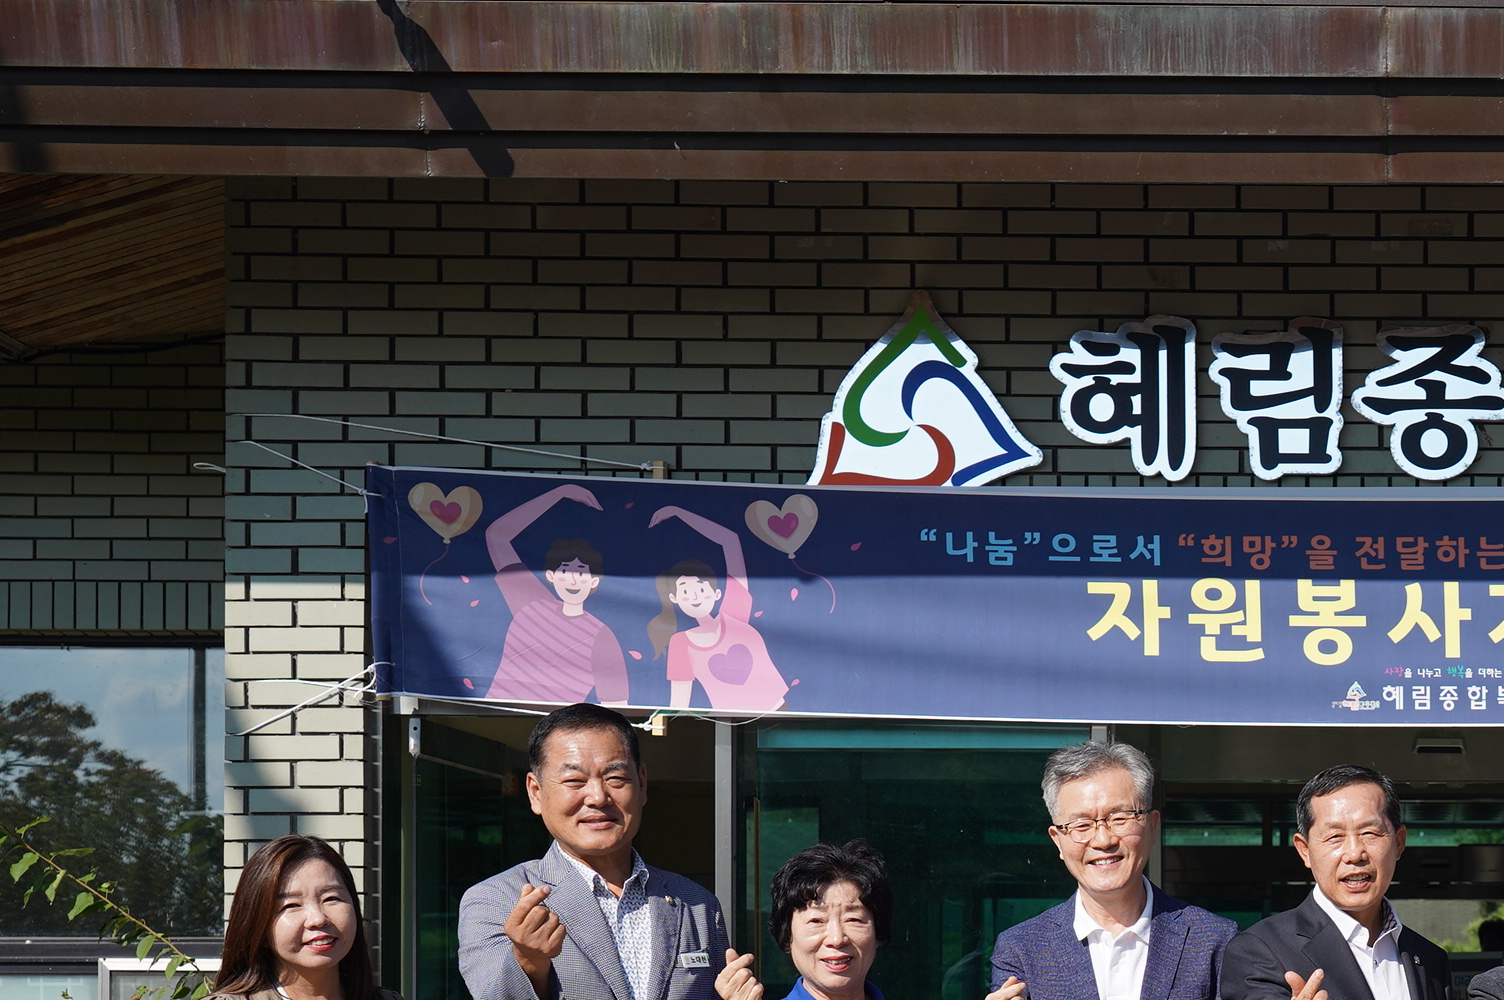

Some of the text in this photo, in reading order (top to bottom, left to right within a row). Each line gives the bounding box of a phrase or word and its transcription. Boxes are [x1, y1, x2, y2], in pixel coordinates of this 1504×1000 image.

[1384, 664, 1503, 679] 사랑을 나누고 행복을 더하는
